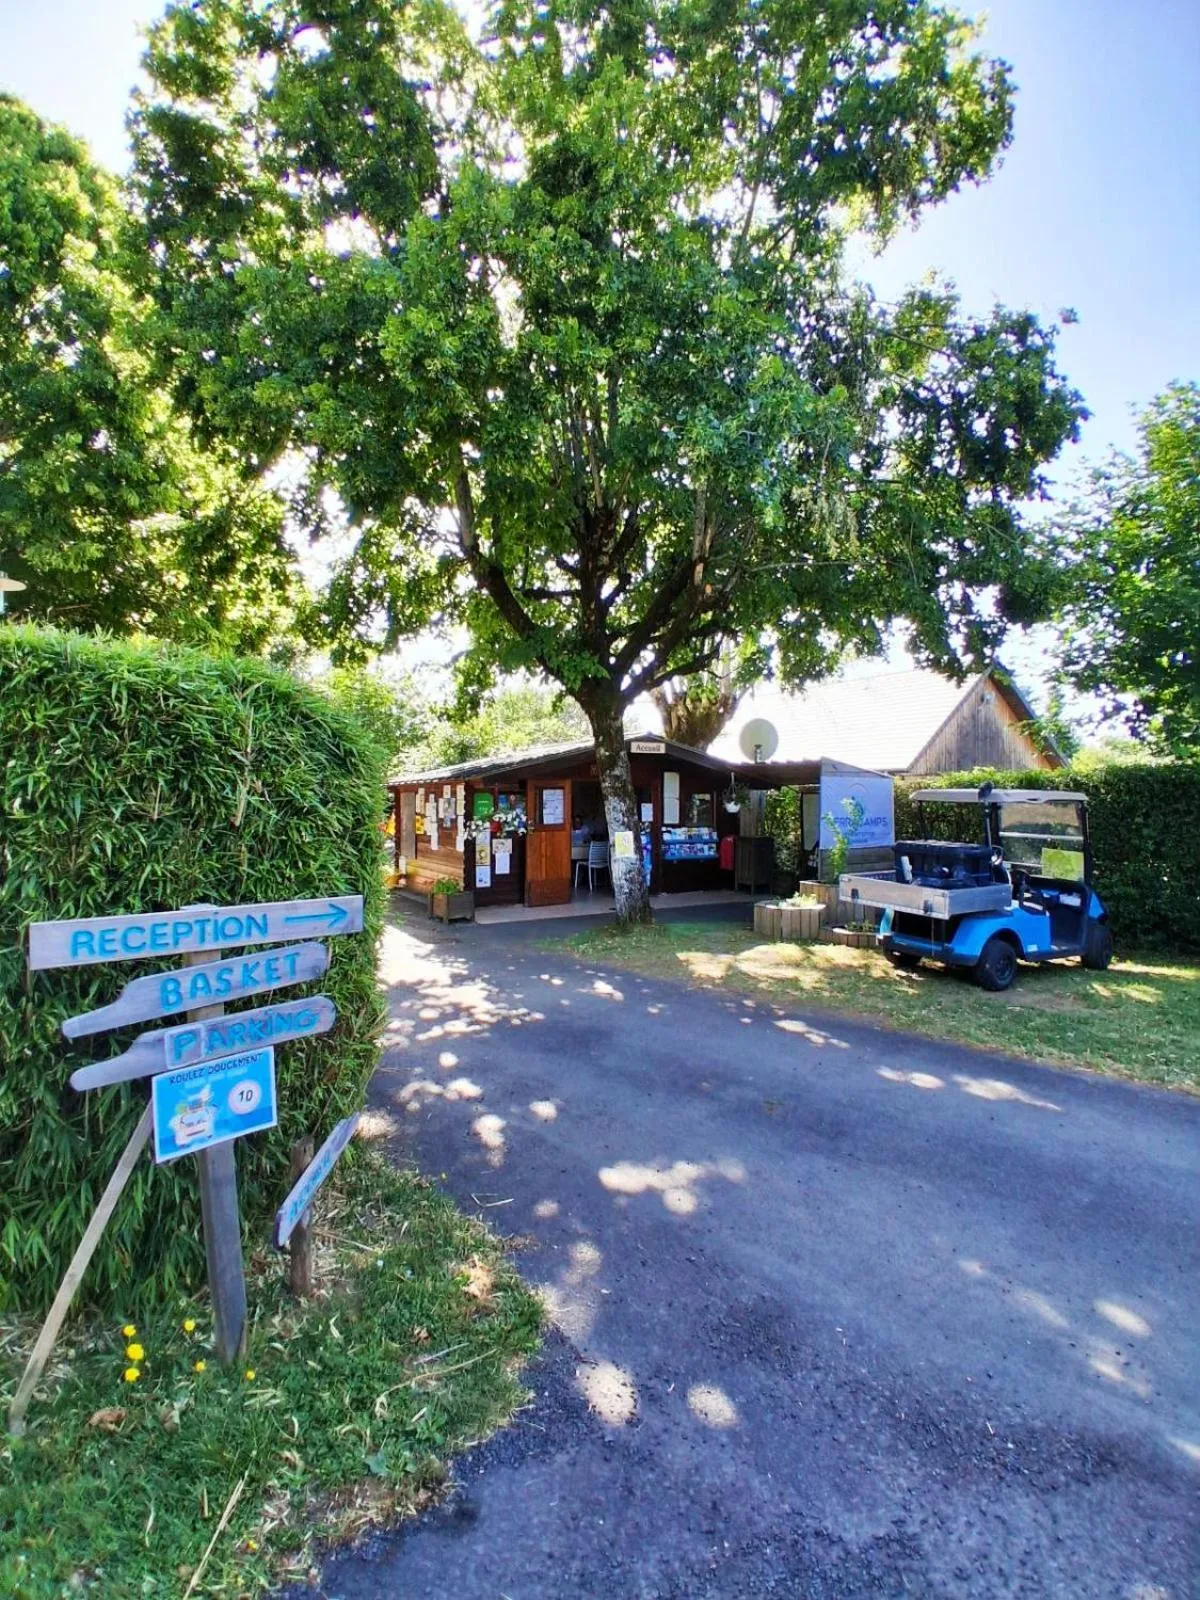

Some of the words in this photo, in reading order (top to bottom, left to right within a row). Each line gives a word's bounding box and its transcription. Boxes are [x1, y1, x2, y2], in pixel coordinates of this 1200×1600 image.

[159, 952, 300, 1012] BASKET
[169, 1068, 205, 1085] ROULEZ
[208, 1053, 264, 1075] DOUCEMENT
[238, 1089, 254, 1103] 10
